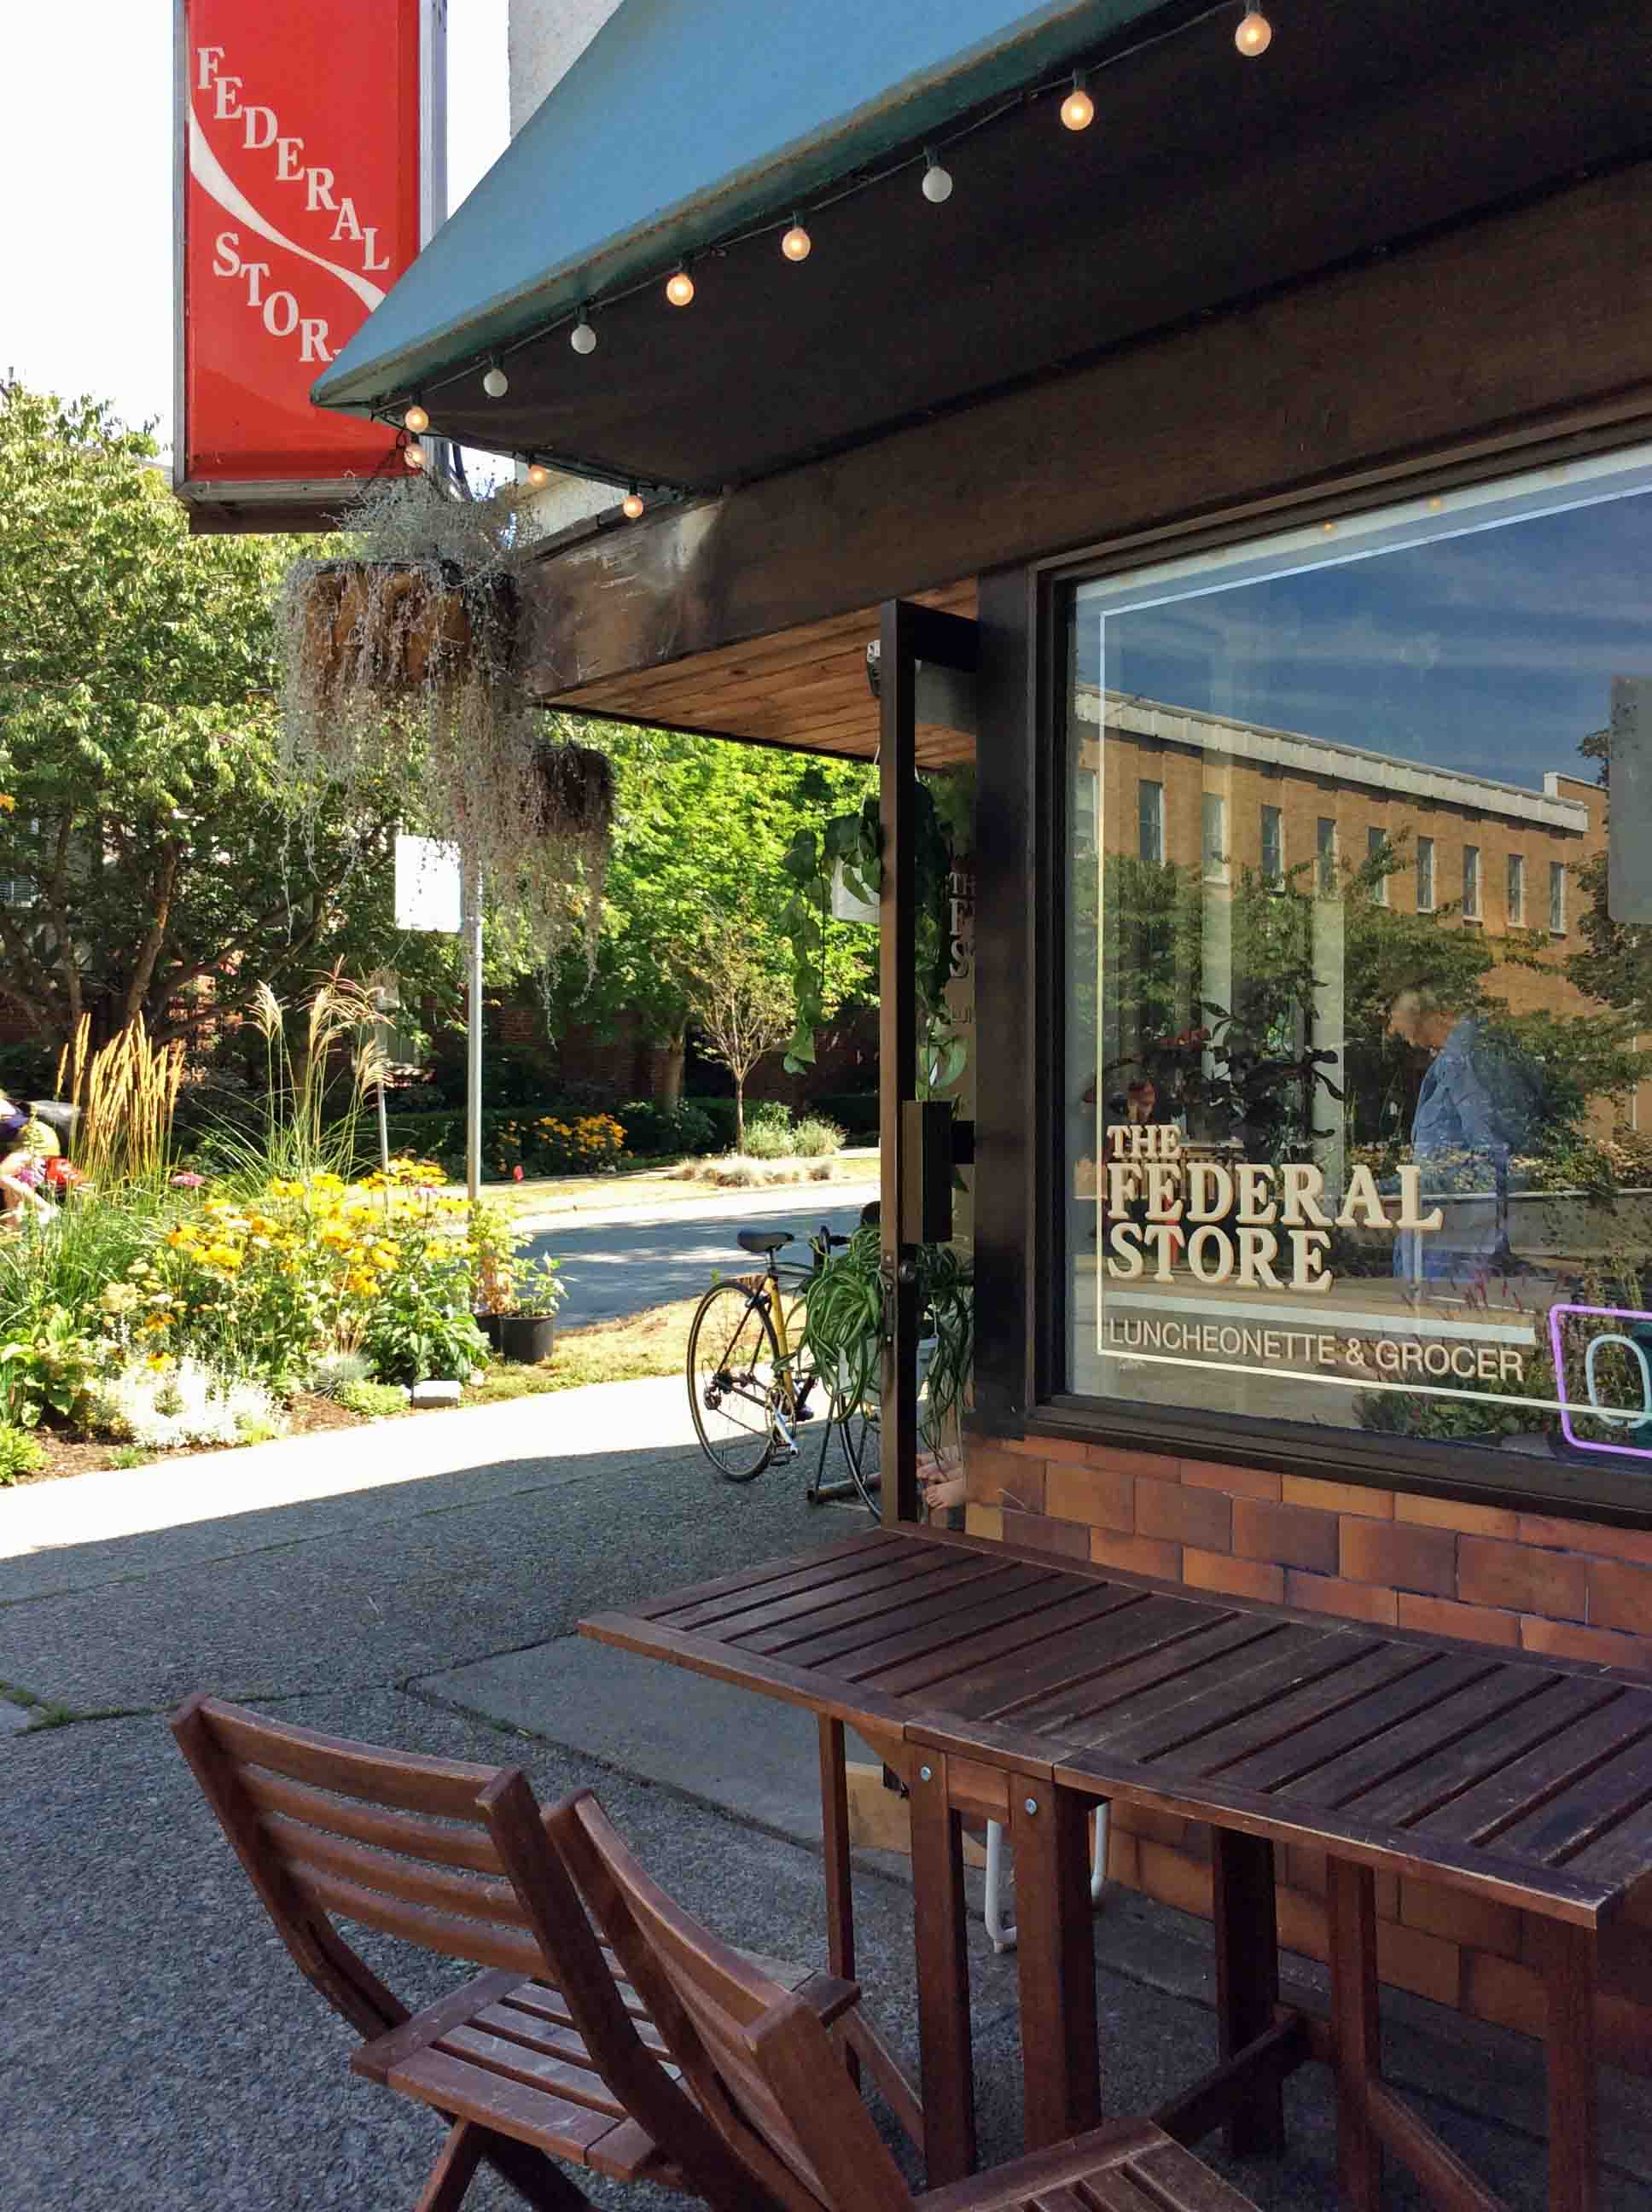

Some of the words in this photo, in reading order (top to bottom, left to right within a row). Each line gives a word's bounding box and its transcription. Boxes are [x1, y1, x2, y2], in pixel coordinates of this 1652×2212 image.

[196, 46, 390, 271] FEDERAL
[212, 231, 341, 363] STOR
[1107, 1124, 1181, 1160] THE
[1107, 1162, 1444, 1231] FEDERAL
[1107, 1222, 1334, 1293] STORE
[1109, 1317, 1339, 1366] LUNCHEONETTE
[1345, 1337, 1366, 1366] &
[1376, 1338, 1525, 1382] GROCER
